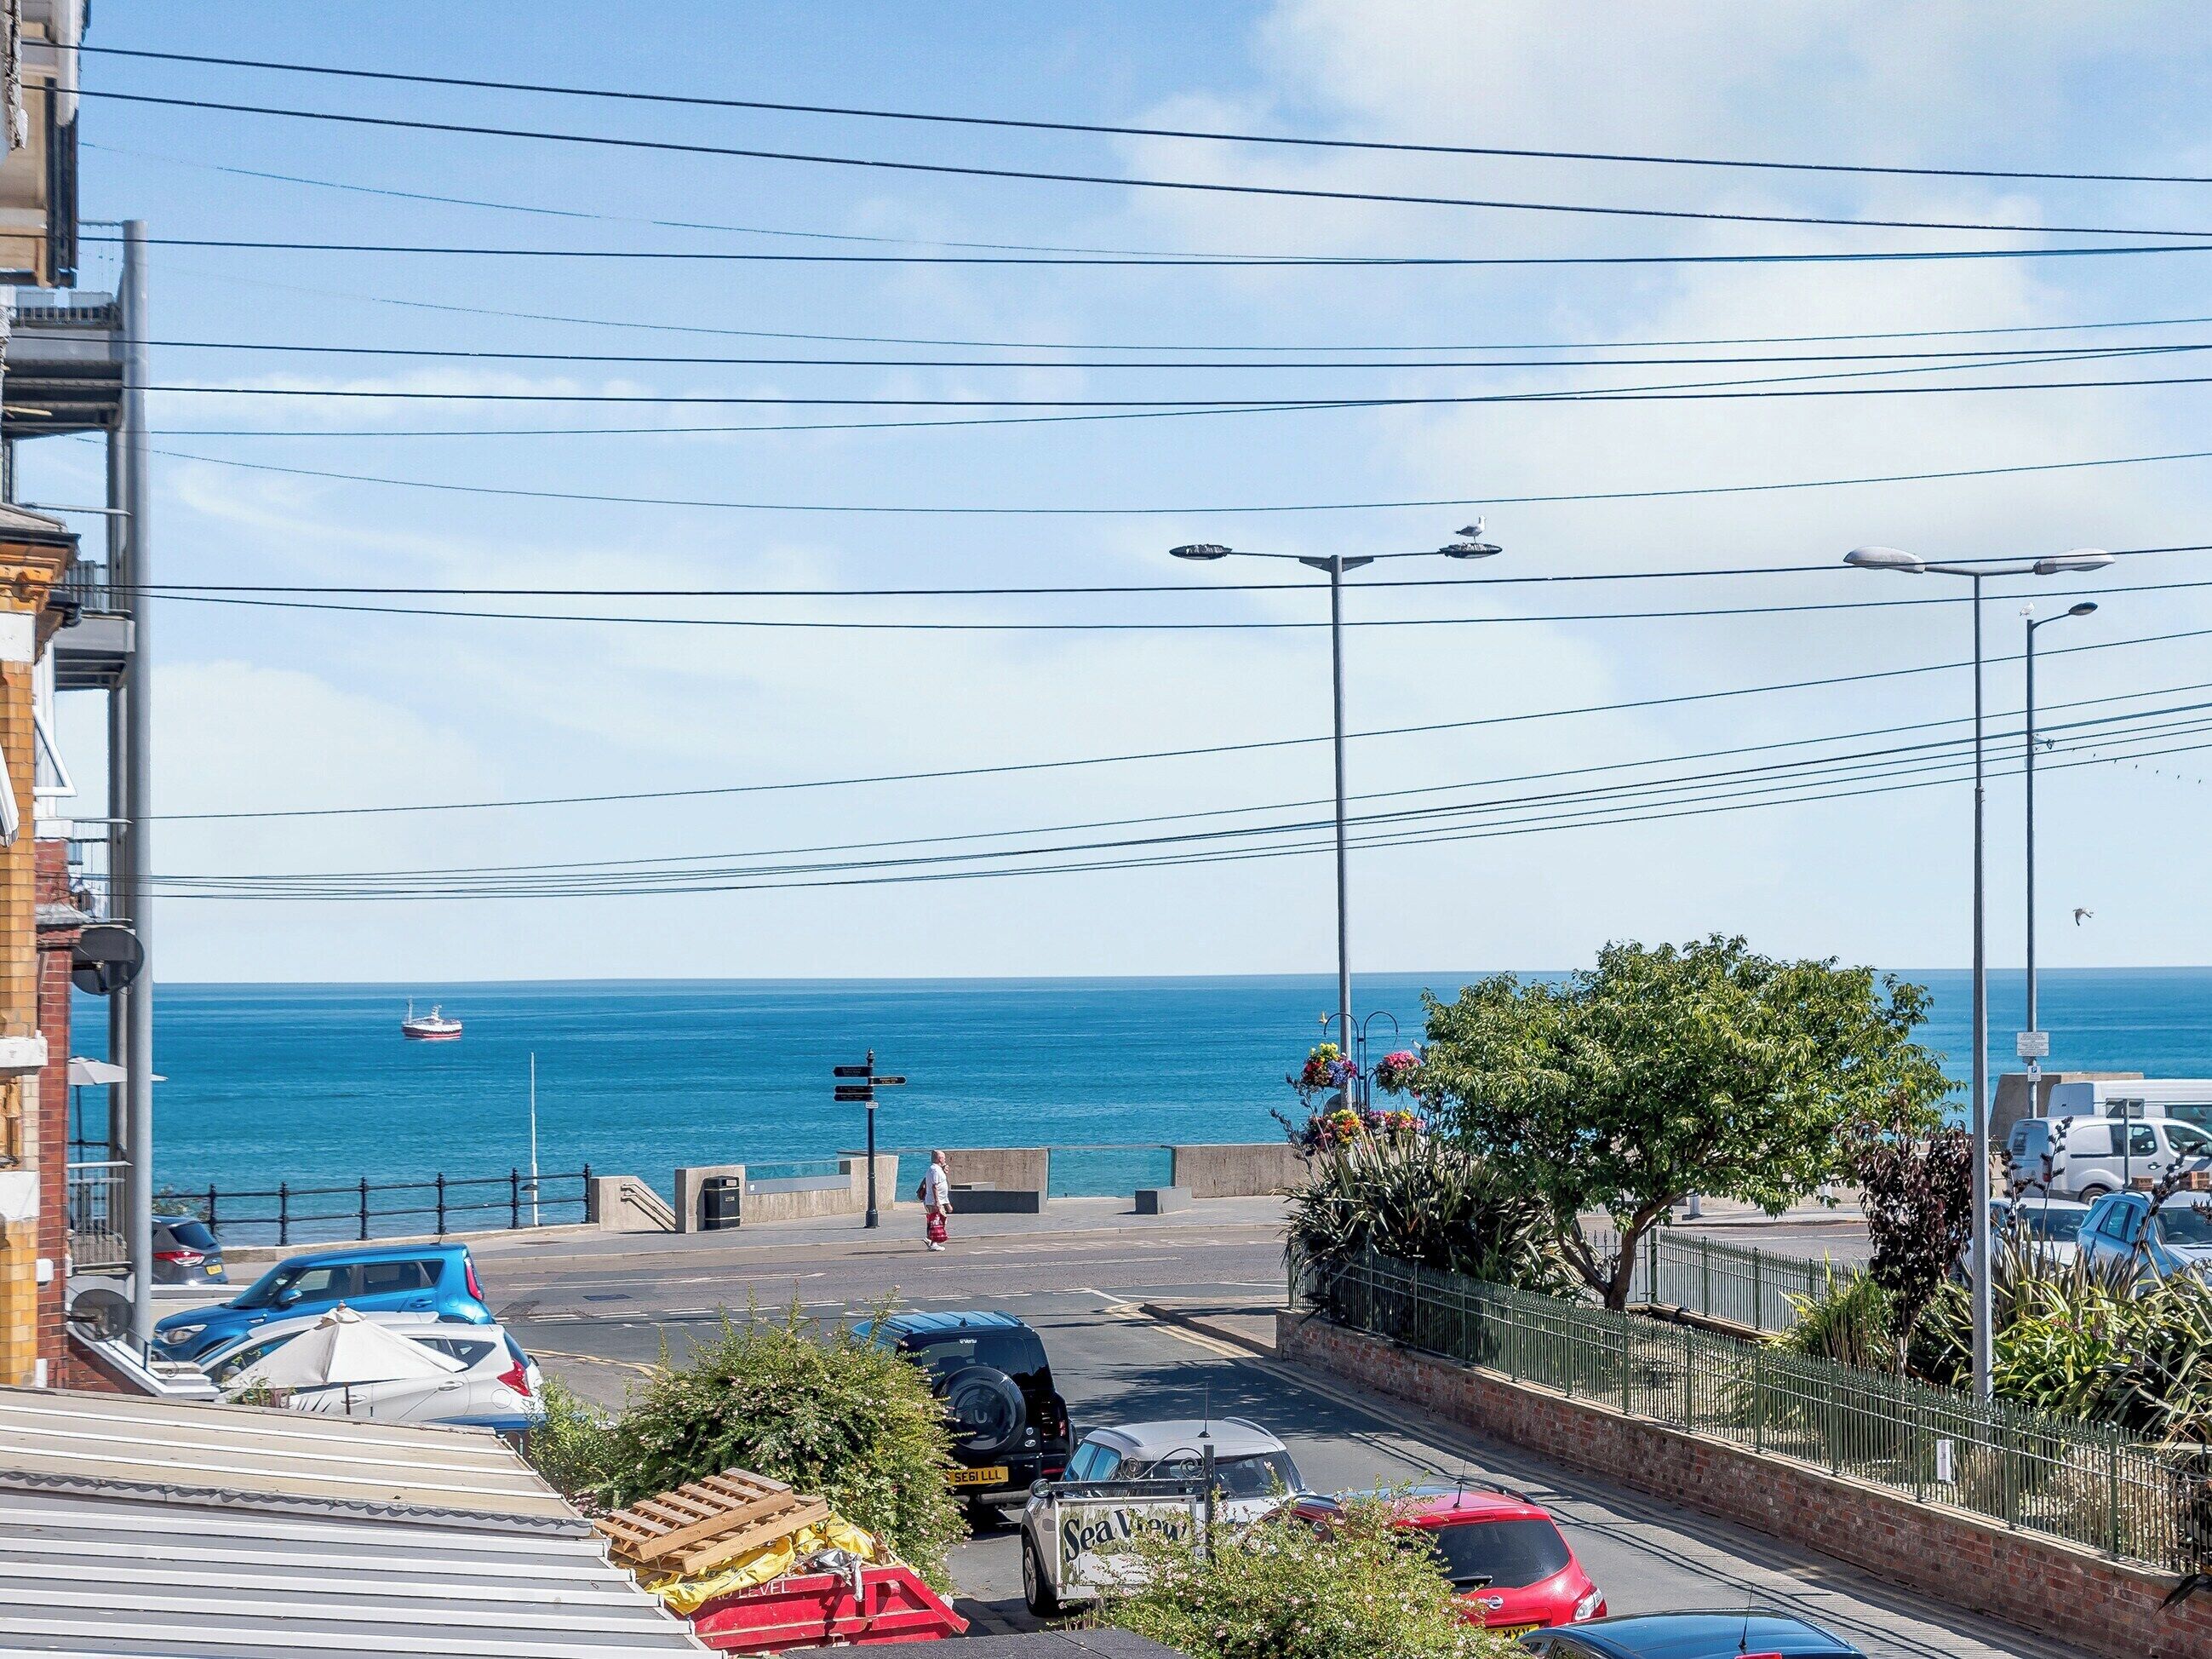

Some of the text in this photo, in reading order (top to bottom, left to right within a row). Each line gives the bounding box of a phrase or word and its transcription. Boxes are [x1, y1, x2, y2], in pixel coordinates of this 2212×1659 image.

[954, 1470, 1002, 1483] SE61 LLL
[1063, 1518, 1115, 1563] Sea
